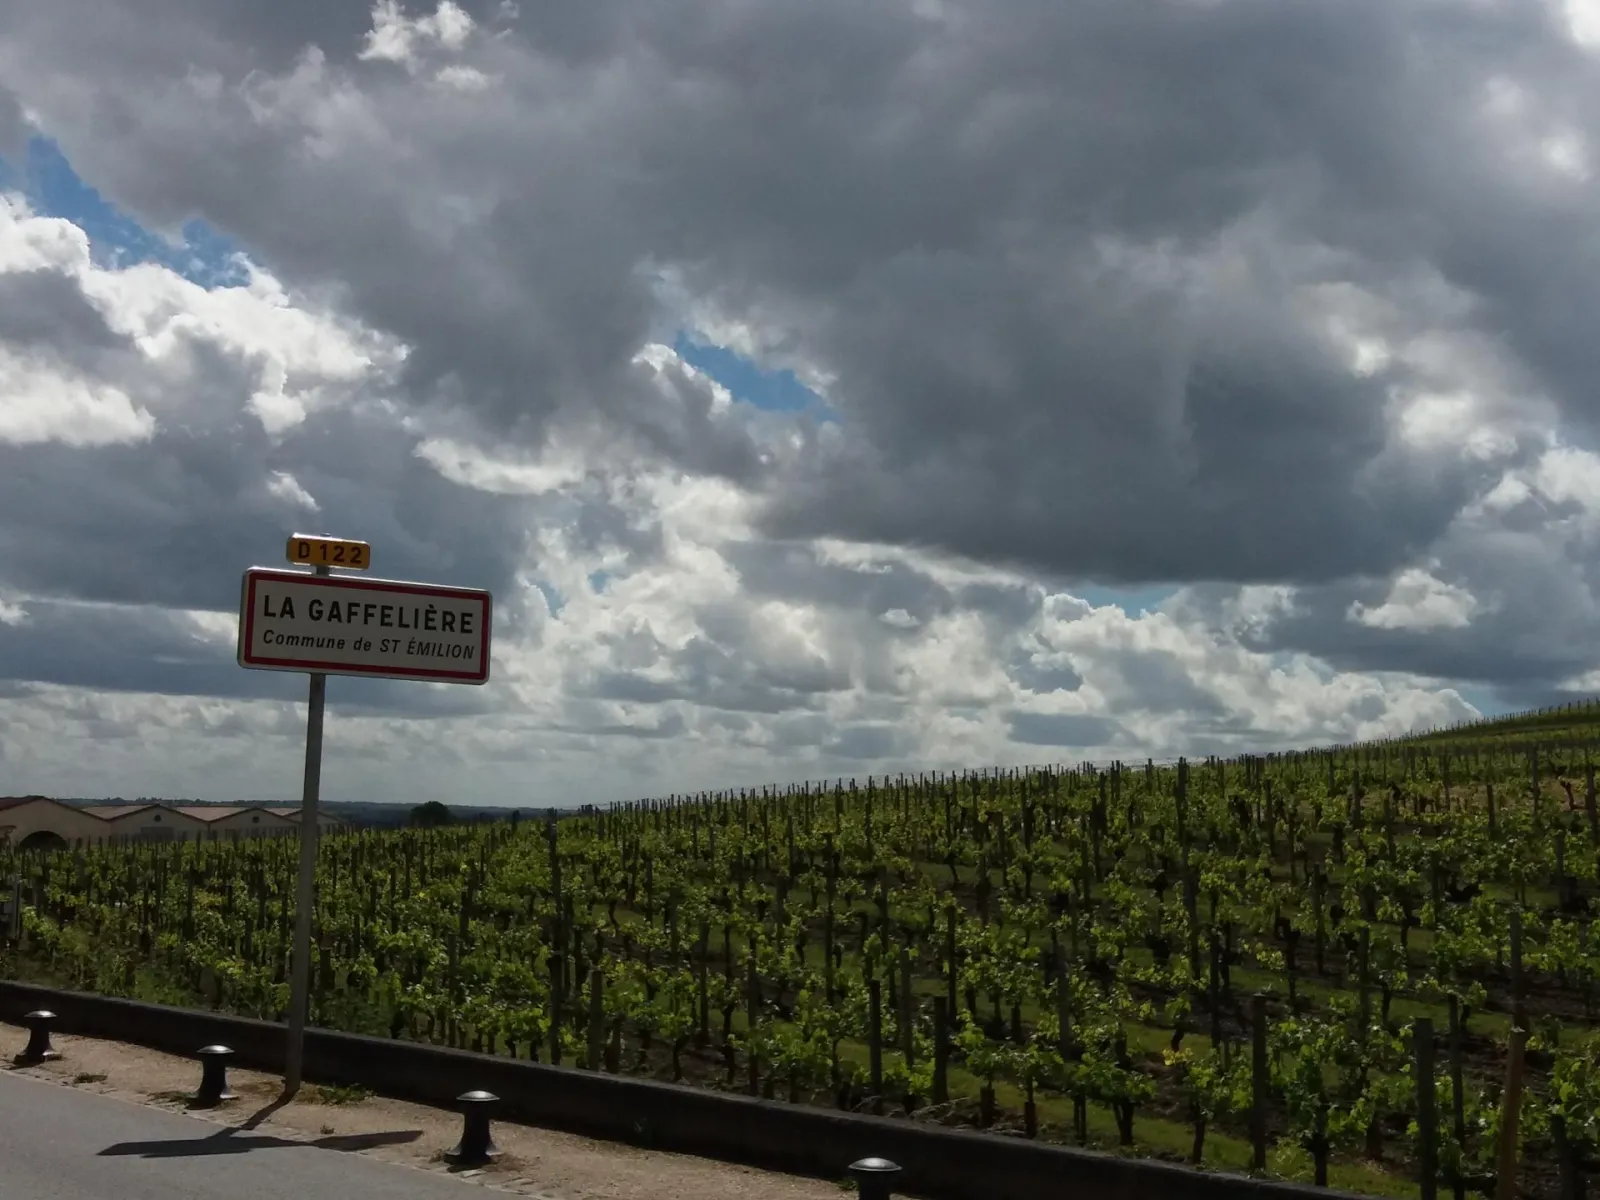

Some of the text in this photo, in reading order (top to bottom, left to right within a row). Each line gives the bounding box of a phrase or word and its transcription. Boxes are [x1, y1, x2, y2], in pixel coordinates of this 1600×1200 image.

[263, 594, 474, 634] LA GAFFELIÈRE
[263, 629, 475, 660] Commune de ST ÉMILION
